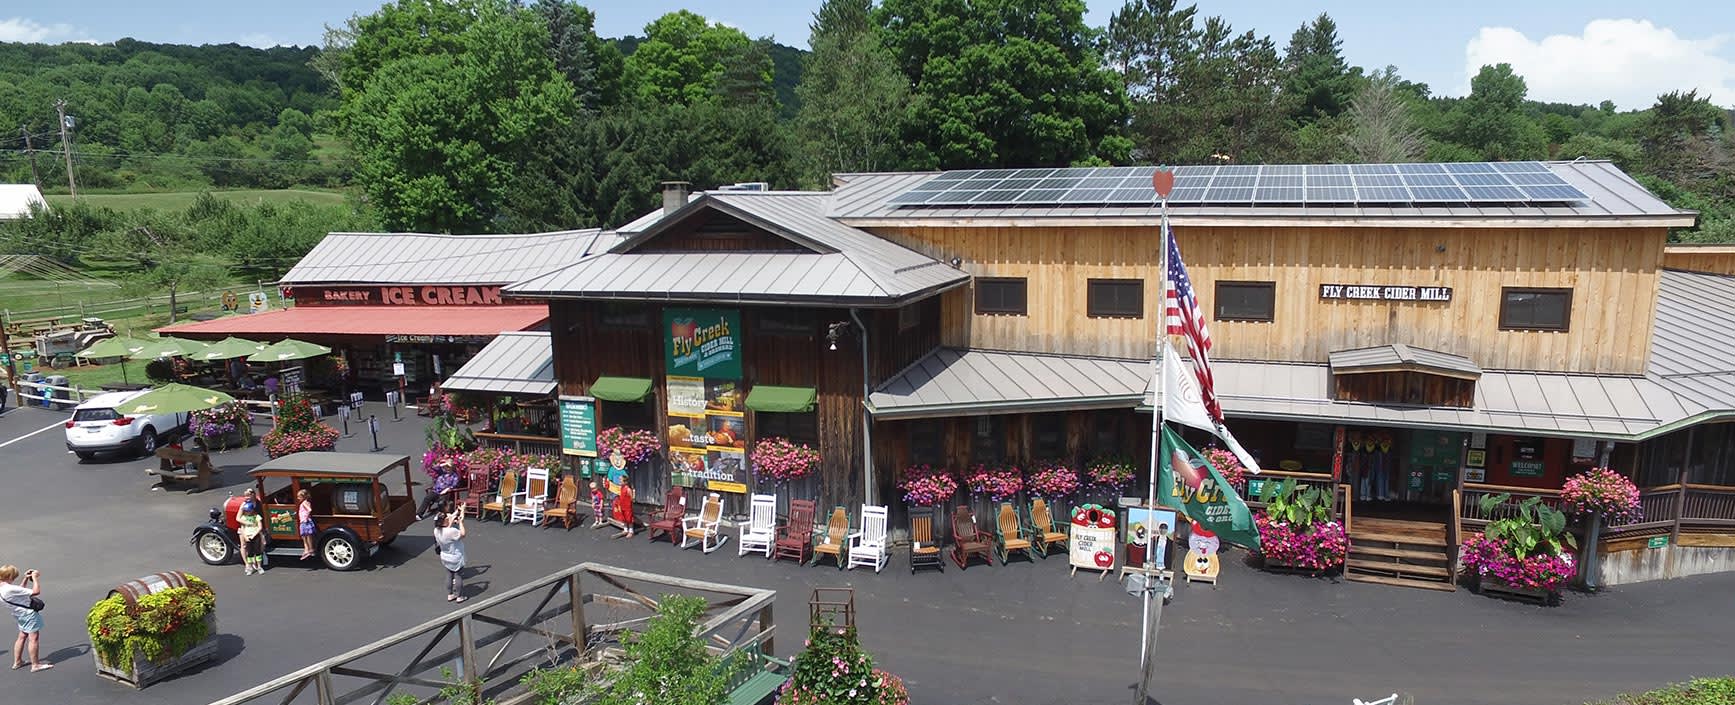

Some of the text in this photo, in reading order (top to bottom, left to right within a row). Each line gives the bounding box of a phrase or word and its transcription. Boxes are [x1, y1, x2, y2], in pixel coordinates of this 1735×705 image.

[324, 286, 502, 305] BAKERY ICE CREAM
[1322, 285, 1450, 301] FLY CREEK CIDER MILL
[673, 316, 729, 357] Fly Creek
[672, 395, 708, 410] History
[1205, 505, 1231, 516] CIDE
